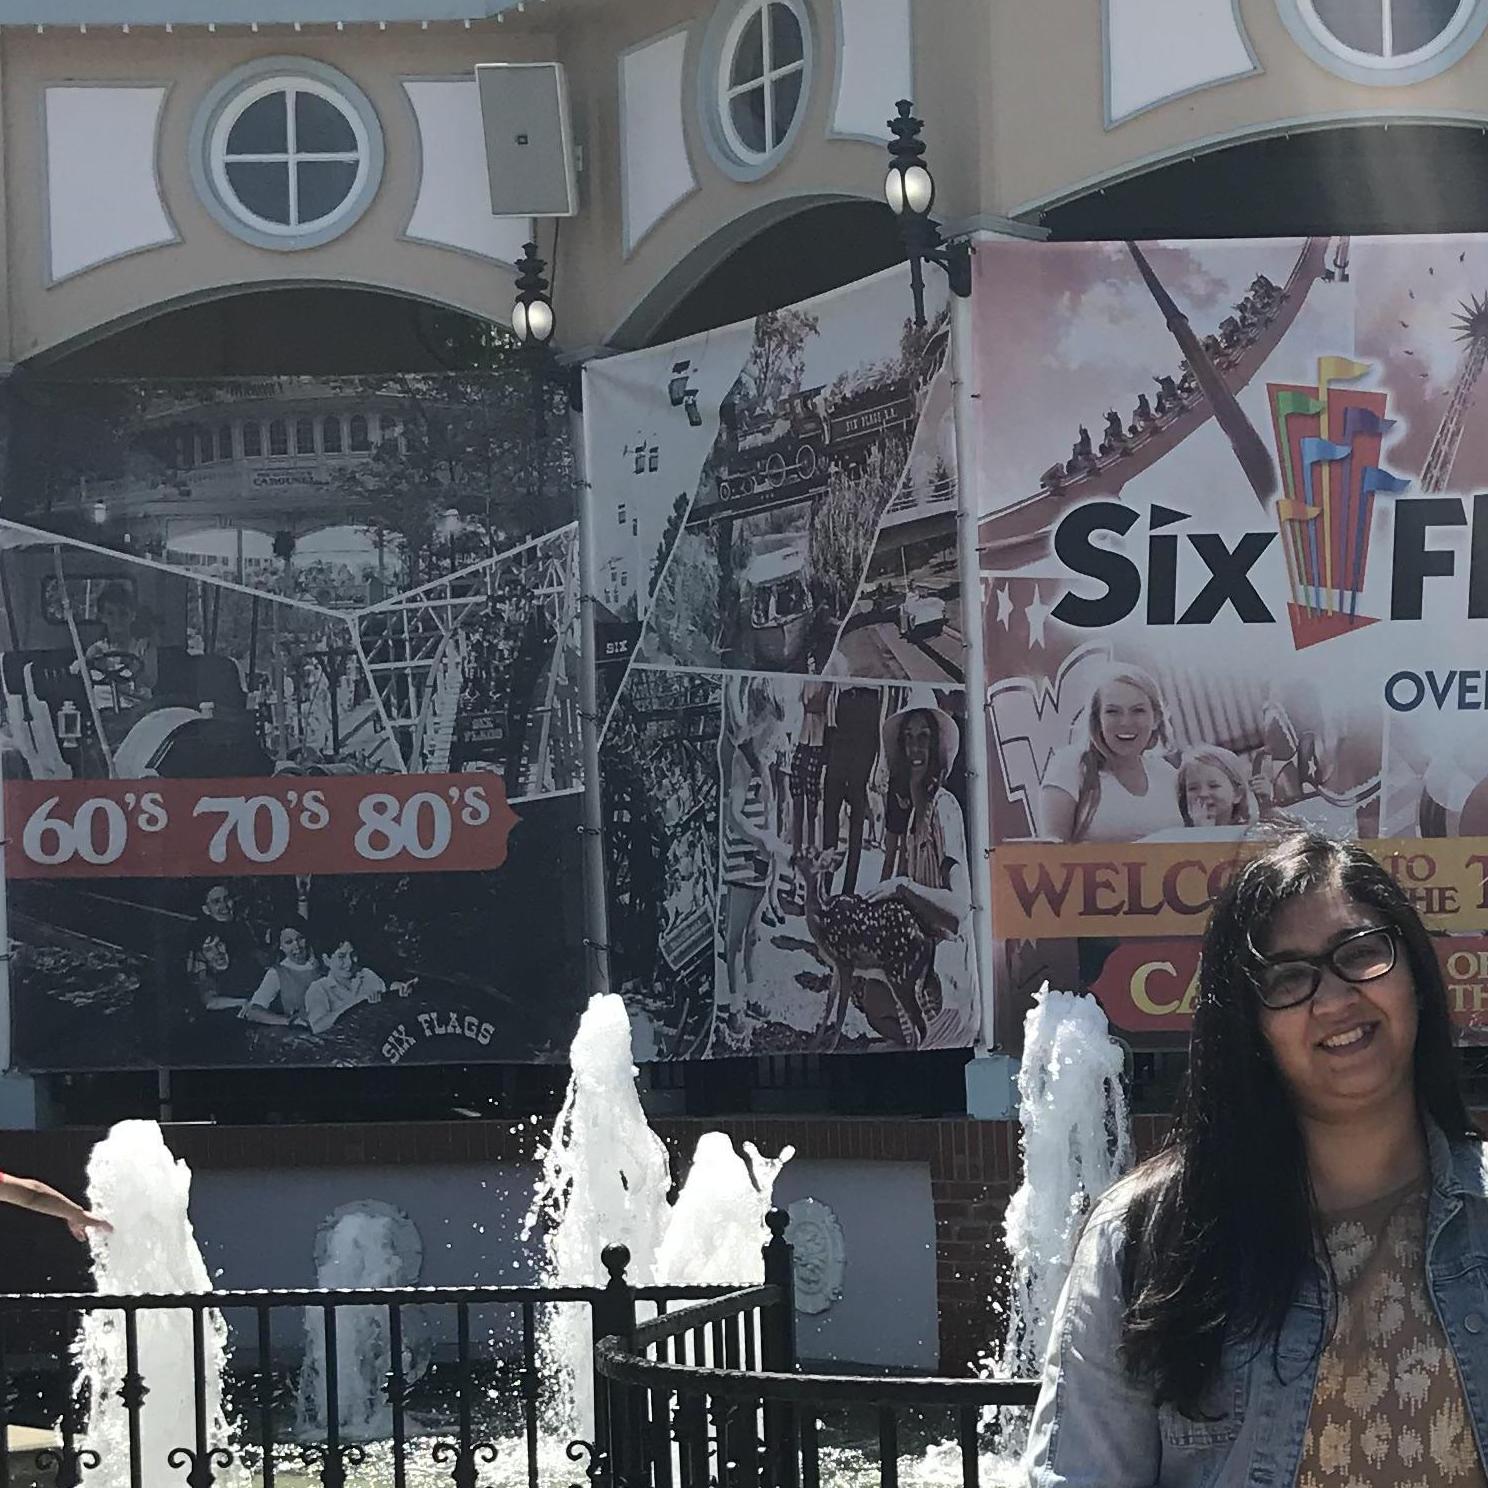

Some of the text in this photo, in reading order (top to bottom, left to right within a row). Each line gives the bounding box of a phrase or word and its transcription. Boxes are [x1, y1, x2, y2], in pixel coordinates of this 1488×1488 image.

[1050, 501, 1279, 628] Six
[606, 639, 628, 655] SIX
[1384, 854, 1437, 882] TO
[1003, 858, 1241, 919] WELC
[1404, 886, 1461, 914] HE
[382, 1011, 495, 1064] SIX FLAGS
